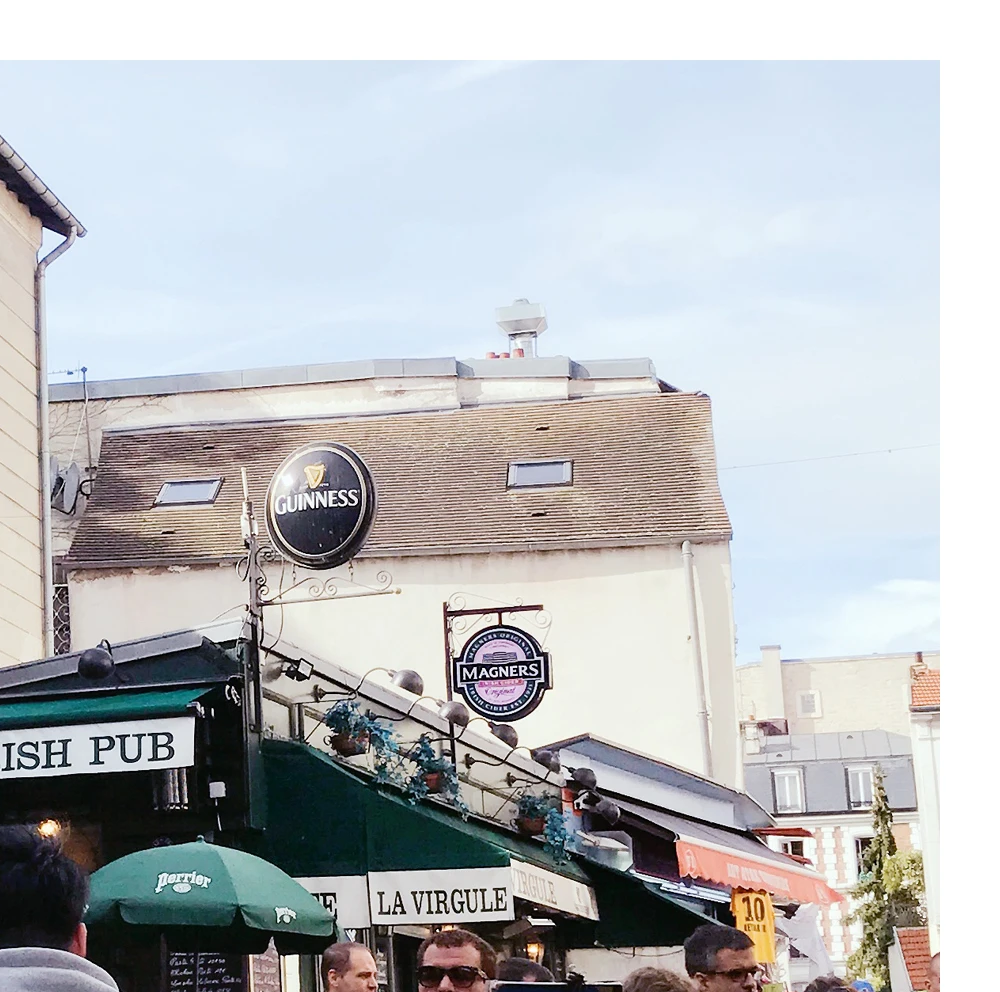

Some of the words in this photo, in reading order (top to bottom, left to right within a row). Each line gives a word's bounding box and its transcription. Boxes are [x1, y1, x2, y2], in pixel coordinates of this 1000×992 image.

[274, 489, 359, 515] GUINNESS
[462, 663, 539, 680] MAGNERS
[89, 731, 175, 766] PUB
[377, 891, 407, 916] LA
[410, 887, 508, 915] VIRGULE
[741, 896, 765, 922] 10
